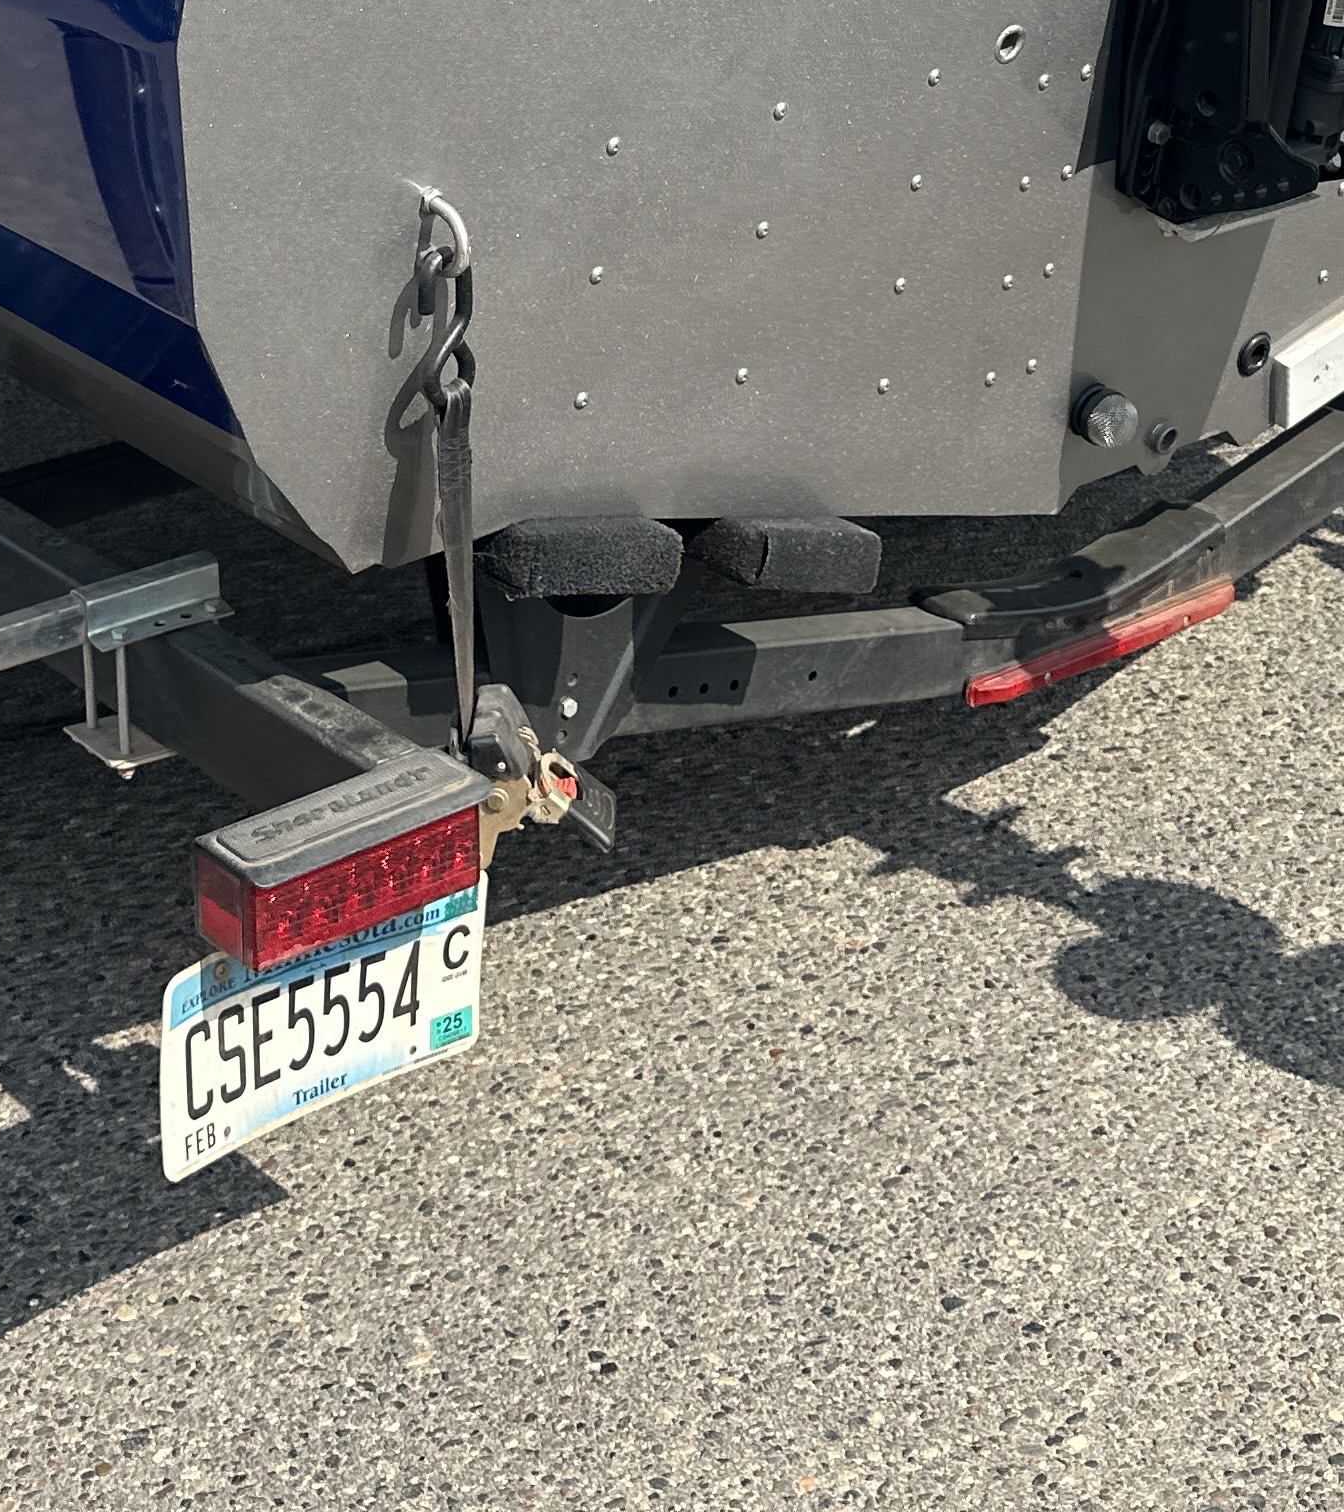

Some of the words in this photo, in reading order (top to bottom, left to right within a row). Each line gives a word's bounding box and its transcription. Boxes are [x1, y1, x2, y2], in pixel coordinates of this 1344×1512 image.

[443, 924, 471, 970] C
[181, 976, 238, 1015] EXPLORE
[185, 939, 421, 1121] CSE5554
[293, 1072, 348, 1106] Trailer
[184, 1122, 217, 1162] FEB
